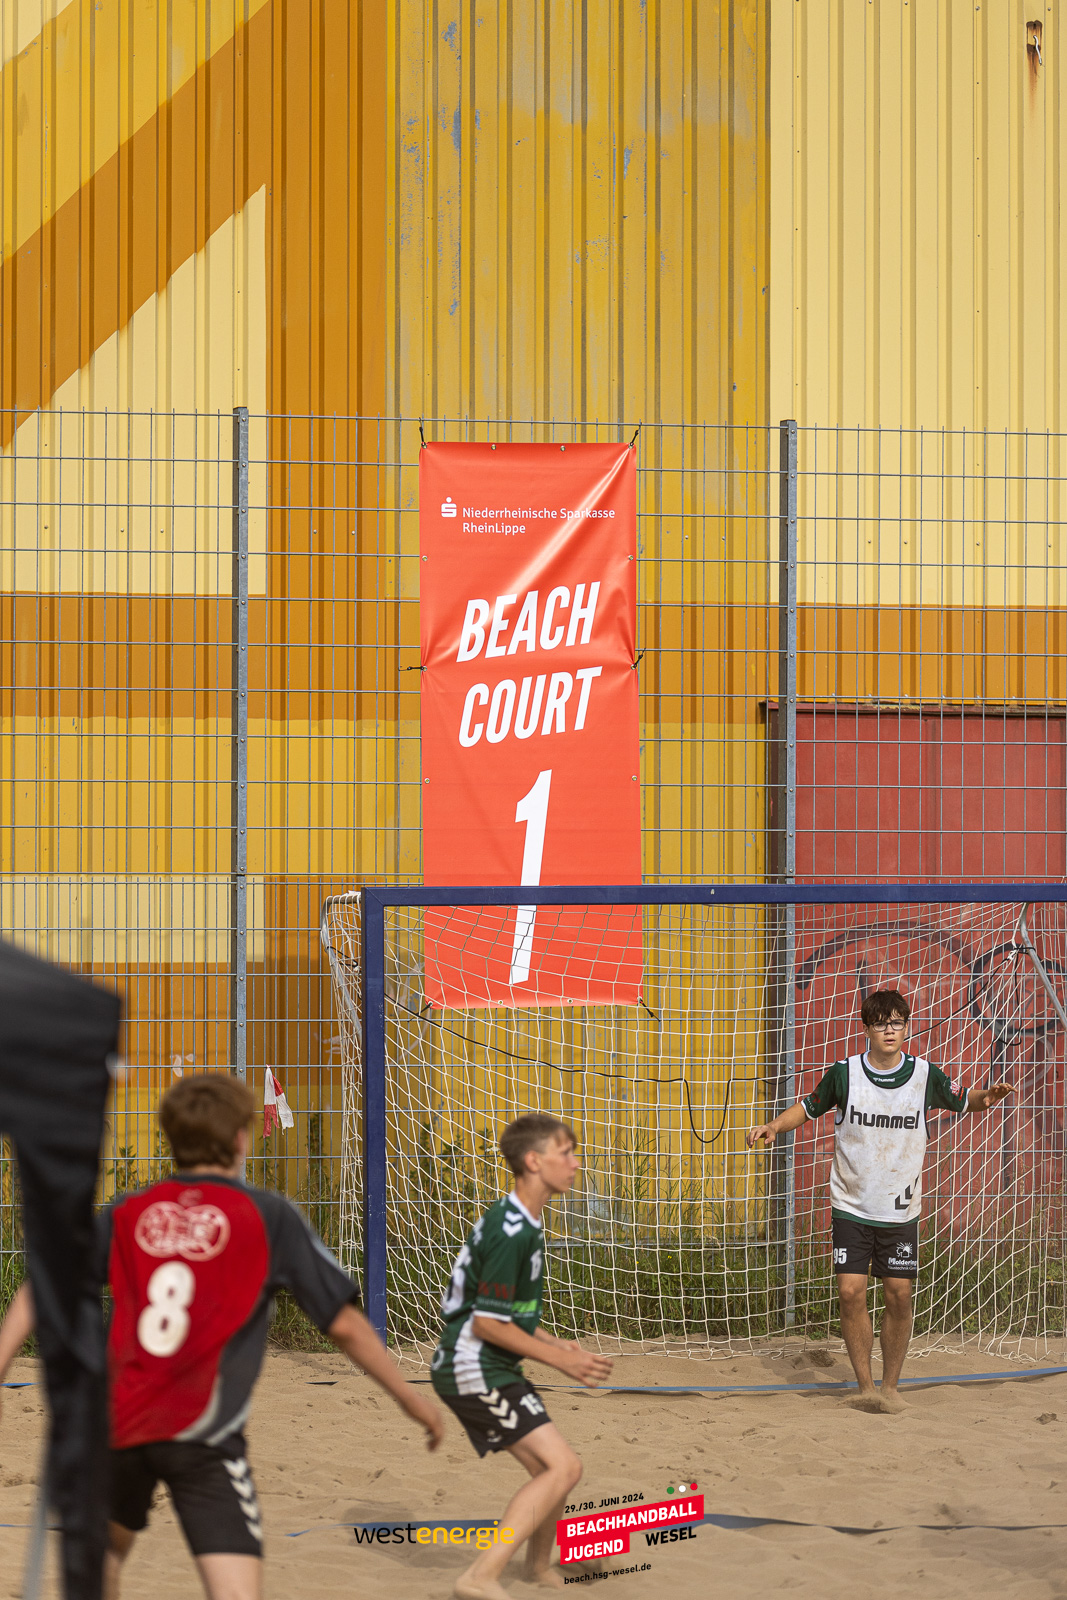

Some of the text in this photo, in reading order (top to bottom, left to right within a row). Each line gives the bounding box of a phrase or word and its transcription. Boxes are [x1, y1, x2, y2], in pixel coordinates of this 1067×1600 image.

[462, 507, 616, 521] Niederrheinische Sparkasse
[462, 522, 526, 536] RheinLippe
[456, 581, 601, 663] BEACH
[458, 666, 603, 748] COURT
[508, 769, 553, 985] 1
[849, 1105, 920, 1130] hummel
[137, 1260, 197, 1358] 8
